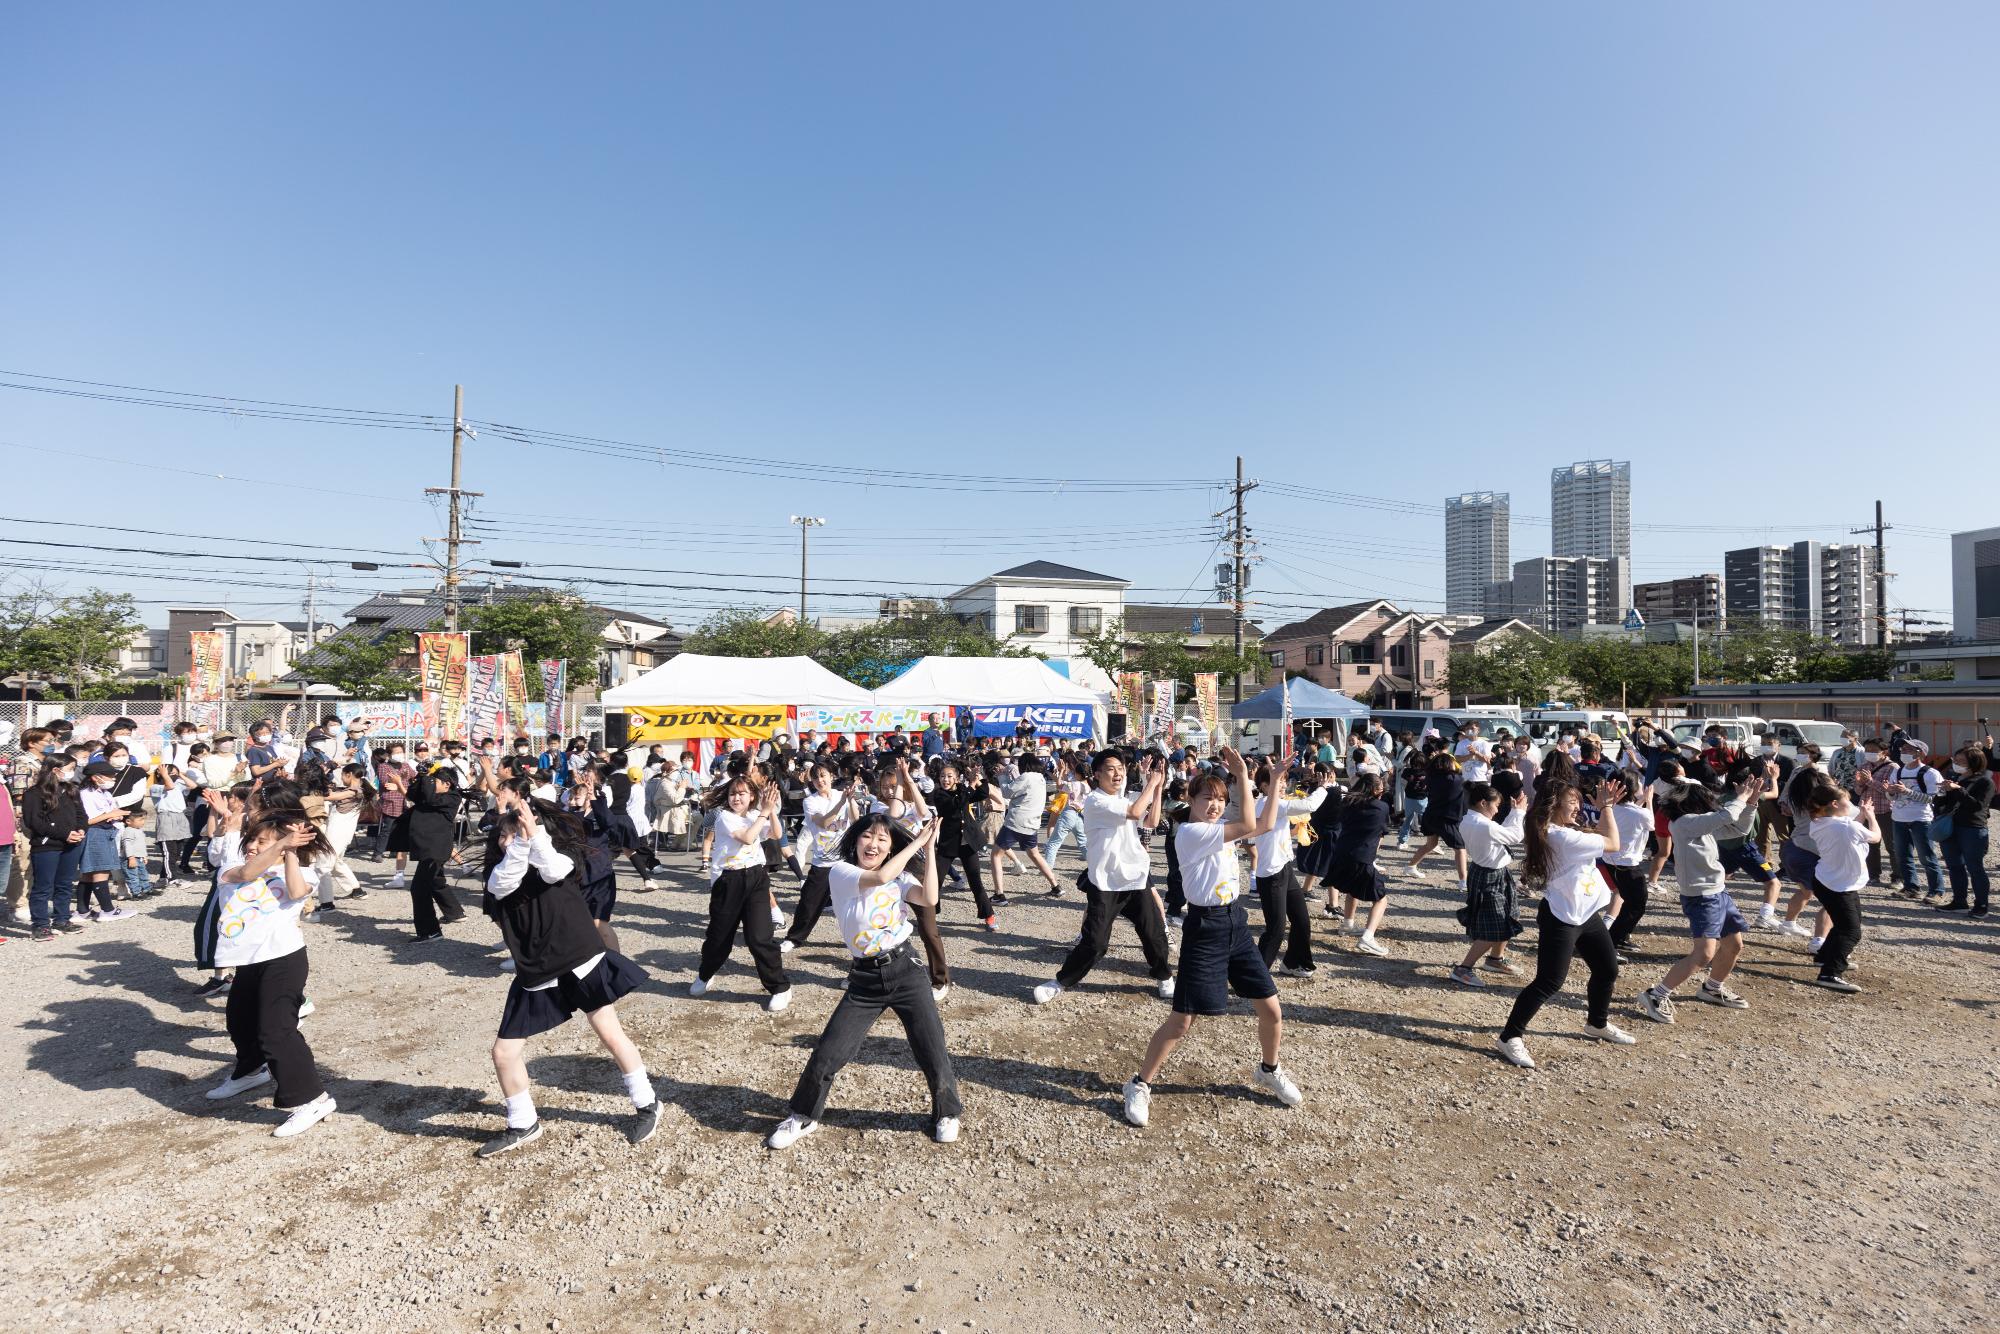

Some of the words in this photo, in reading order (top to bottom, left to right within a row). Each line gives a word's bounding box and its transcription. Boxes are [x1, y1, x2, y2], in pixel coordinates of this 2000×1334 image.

[654, 711, 783, 728] DUNLOP
[818, 709, 919, 727] シーパスパーク
[971, 707, 1086, 724] FALKEN
[1053, 725, 1083, 735] PULSE
